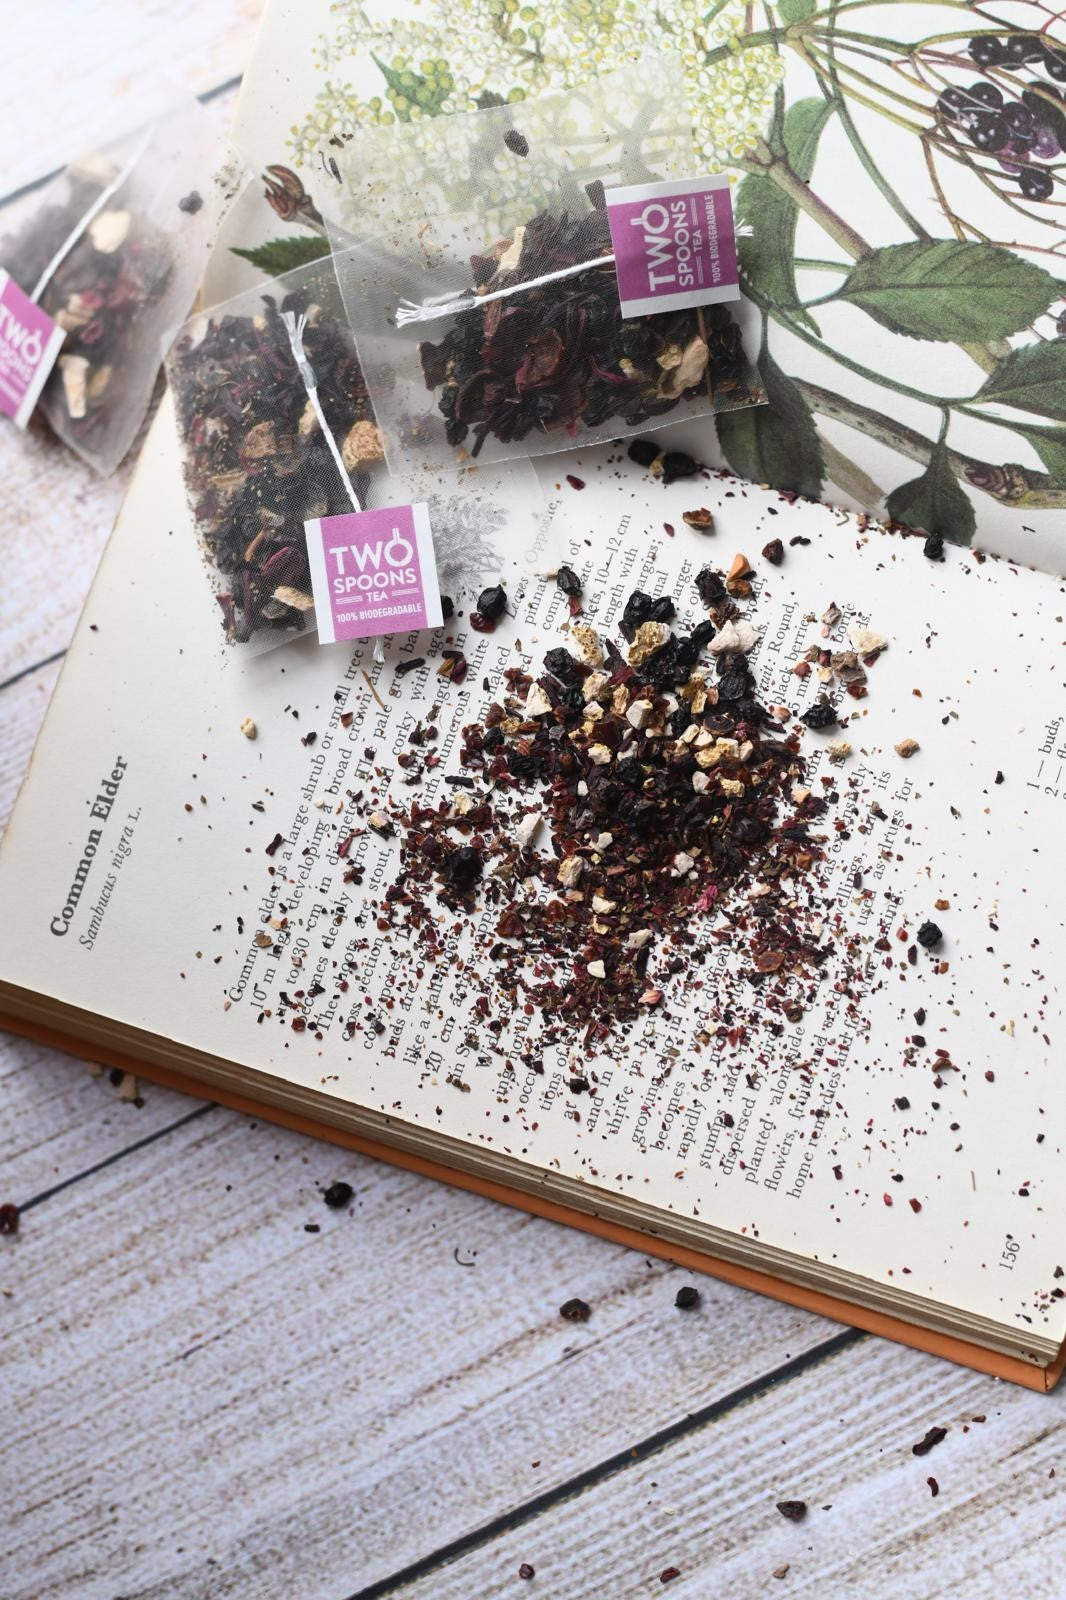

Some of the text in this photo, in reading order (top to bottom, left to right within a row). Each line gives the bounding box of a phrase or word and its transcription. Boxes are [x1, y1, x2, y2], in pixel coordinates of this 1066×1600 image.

[631, 204, 675, 291] TWO
[671, 201, 694, 286] SPOONS
[693, 229, 703, 252] TEA
[704, 194, 721, 283] 100% BIODEGRADABLE
[568, 538, 581, 555] of
[617, 514, 631, 535] cm
[329, 528, 414, 574] TWO
[334, 568, 417, 594] SPOONS
[366, 591, 388, 602] TEA
[598, 584, 624, 628] length
[619, 548, 638, 577] with
[666, 559, 691, 601] larger
[336, 602, 422, 623] 100% BIODEGRADABLE
[677, 610, 693, 631] the
[831, 603, 853, 643] borne
[344, 649, 364, 679] tree
[752, 601, 798, 699] Fruit: Round,
[769, 666, 793, 705] black
[787, 701, 800, 711] 5
[348, 693, 372, 741] crown
[391, 711, 416, 757] corky
[410, 664, 430, 699] with
[321, 732, 333, 749] or
[1026, 781, 1040, 789] 1
[1037, 716, 1064, 753] buds,
[301, 754, 325, 801] shrub
[325, 747, 352, 795] broad
[1044, 786, 1058, 797] 2
[283, 805, 308, 846] large
[314, 1000, 337, 1030] The
[368, 848, 394, 891] stout,
[452, 632, 467, 648] in
[322, 803, 333, 814] a
[358, 937, 385, 993] section
[433, 690, 470, 769] numerous
[463, 639, 489, 681] white
[50, 755, 127, 936] Common Elder
[282, 851, 292, 860] a
[283, 820, 329, 909] developing
[285, 969, 299, 984] to
[292, 937, 309, 957] 30
[307, 903, 322, 928] cm
[315, 876, 331, 893] in
[373, 702, 392, 739] pale
[78, 805, 141, 950] Sambucus nigra L.
[258, 881, 280, 923] elder
[250, 988, 266, 1009] 10
[263, 968, 275, 984] m
[742, 1117, 776, 1183] planted
[872, 770, 890, 790] its
[763, 1129, 799, 1191] flowers,
[872, 863, 885, 879] as
[894, 778, 913, 801] for
[402, 1034, 424, 1065] like
[419, 1019, 430, 1029] a
[425, 1050, 442, 1072] 20
[440, 1016, 455, 1042] cm
[448, 1062, 465, 1078] in
[491, 1068, 516, 1096] ing
[538, 1072, 561, 1110] tions
[555, 1047, 569, 1067] of
[631, 1076, 663, 1144] growing
[665, 1013, 681, 1031] in
[563, 1101, 576, 1119] at
[585, 1094, 604, 1128] and
[599, 1070, 613, 1087] in
[606, 1086, 633, 1134] thrive
[624, 1059, 642, 1075] in
[649, 1081, 685, 1150] becomes
[681, 1063, 692, 1072] a
[676, 1098, 706, 1159] rapidly
[699, 1109, 727, 1168] stumps
[719, 1097, 755, 1175] dispersed
[786, 1152, 813, 1198] home
[999, 1240, 1019, 1270] 156
